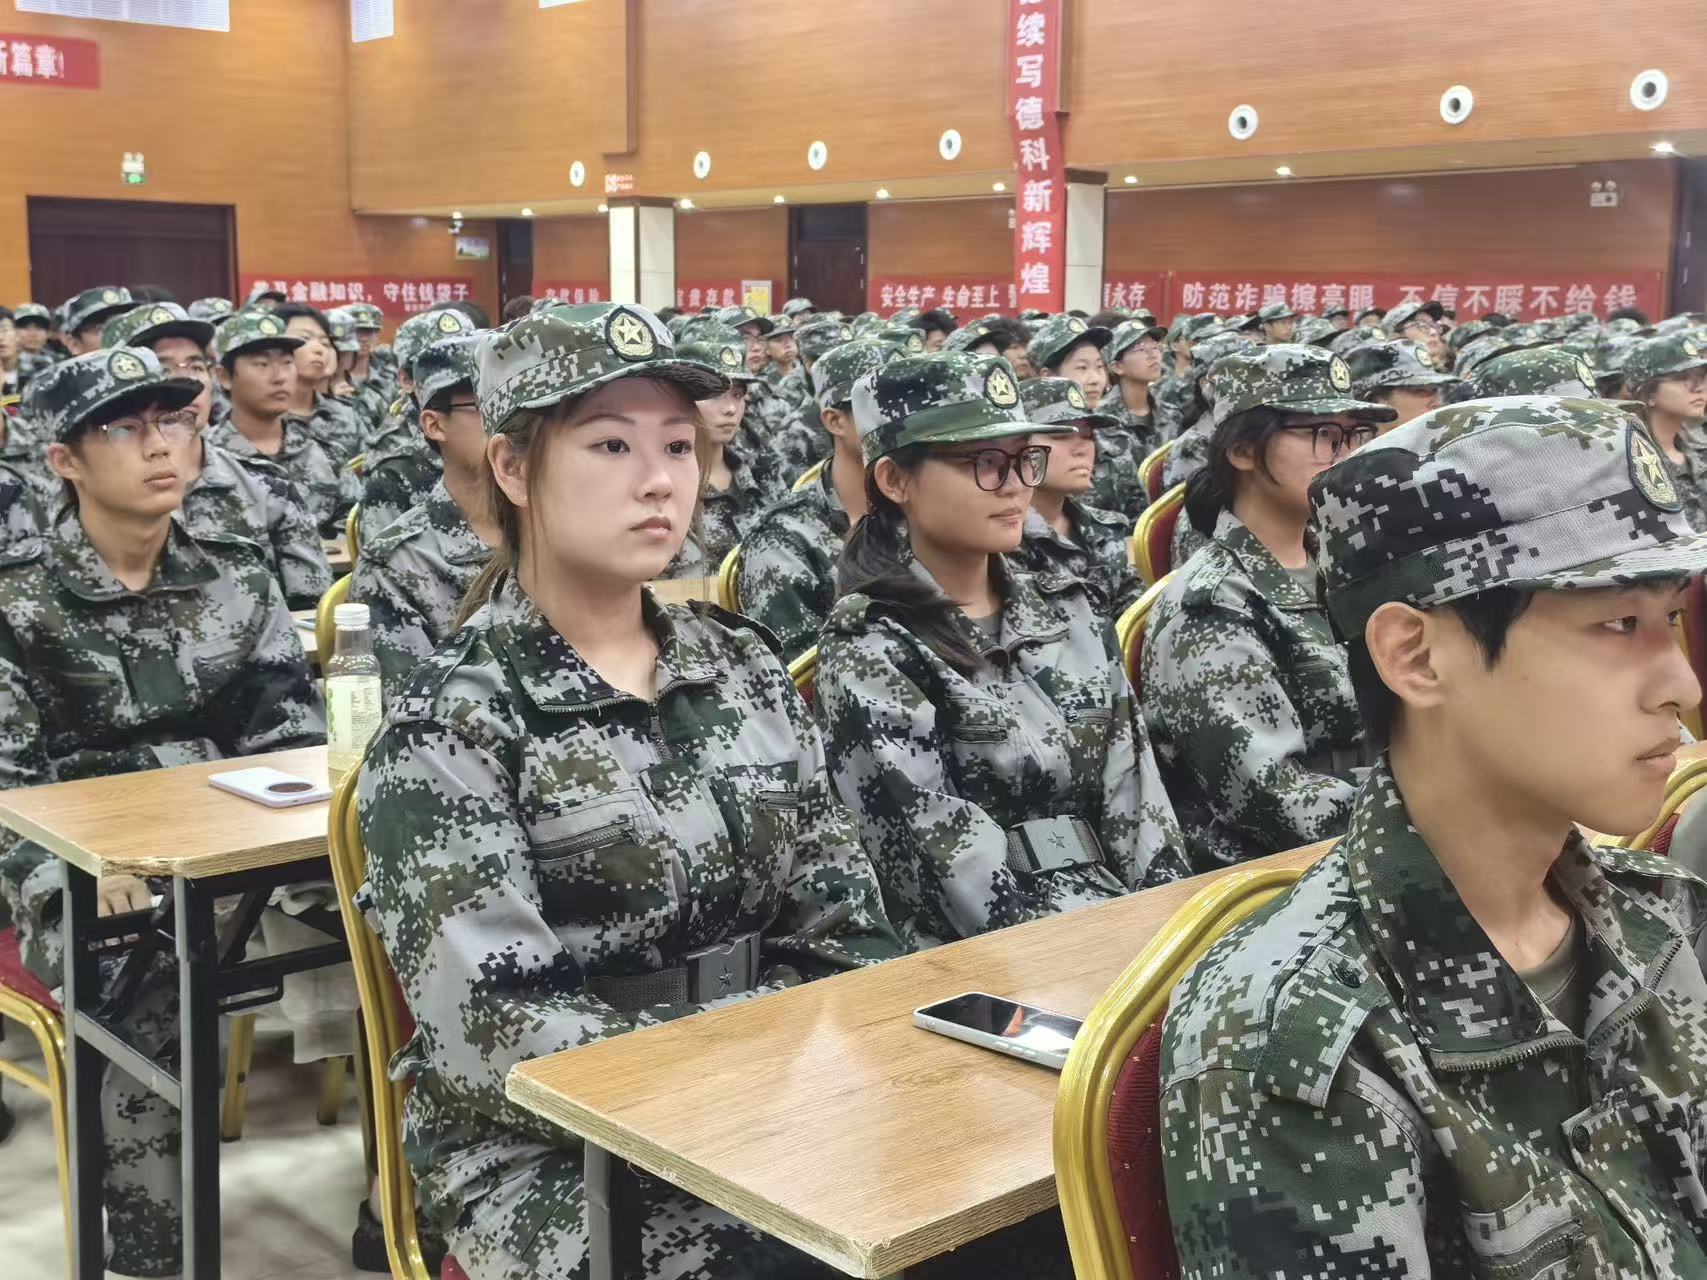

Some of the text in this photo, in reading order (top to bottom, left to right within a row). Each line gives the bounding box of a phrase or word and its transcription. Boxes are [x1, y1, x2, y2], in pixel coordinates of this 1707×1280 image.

[1015, 0, 1053, 294] 续写德科新辉煌
[880, 284, 936, 308] 安全生产
[941, 285, 1000, 308] 生命至上
[1182, 281, 1375, 311] 防范诈骗擦亮眼
